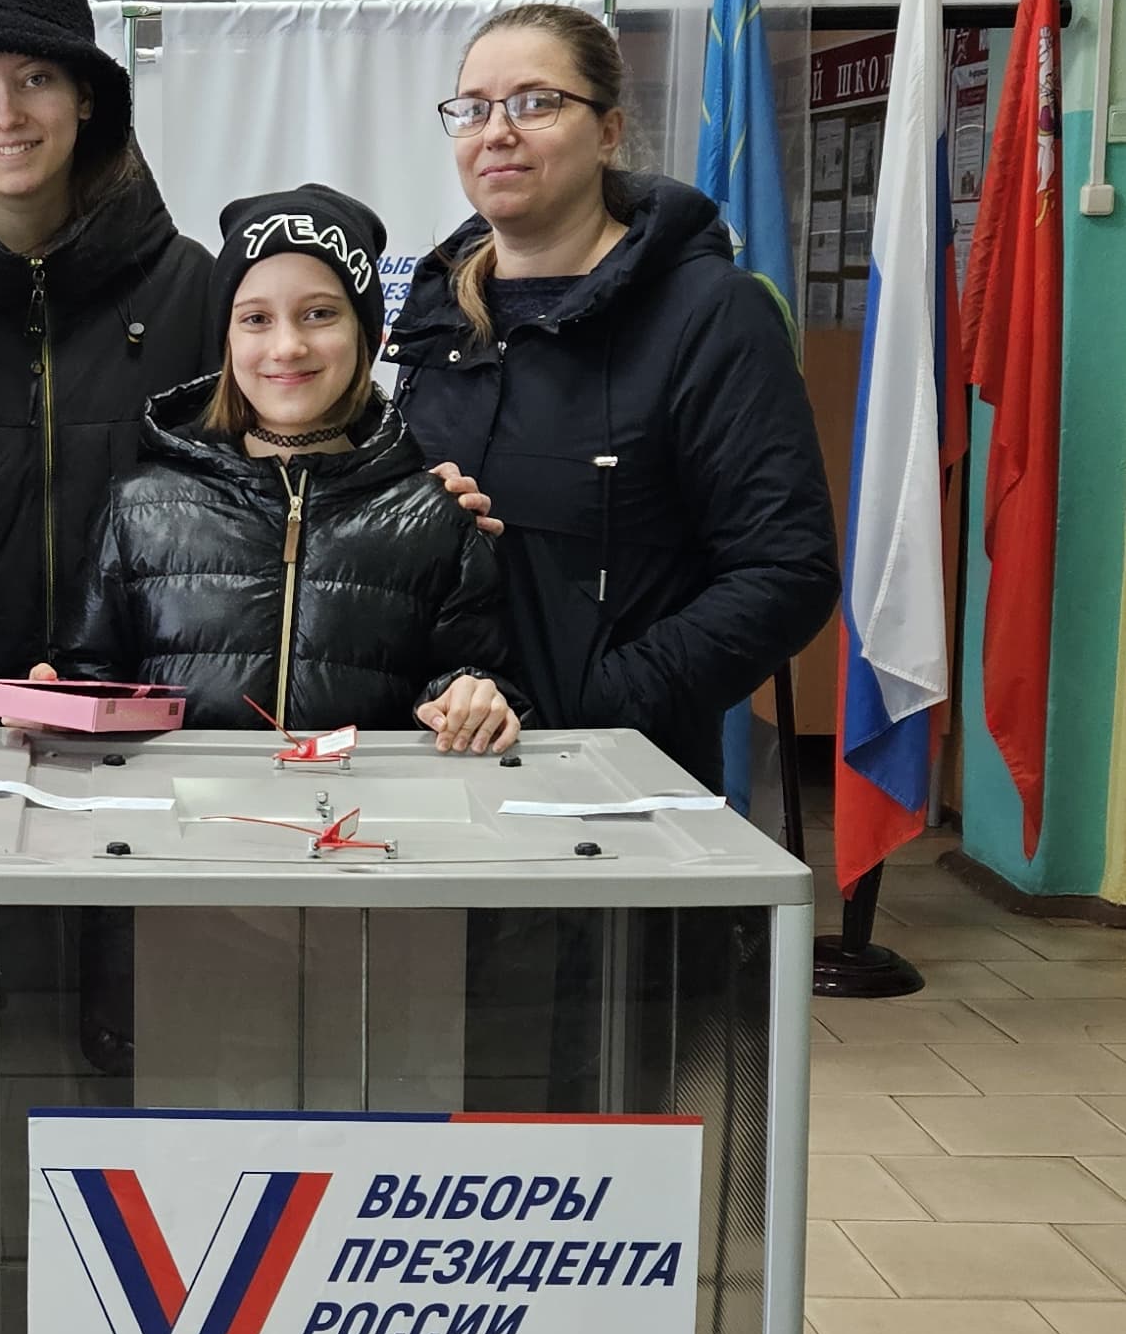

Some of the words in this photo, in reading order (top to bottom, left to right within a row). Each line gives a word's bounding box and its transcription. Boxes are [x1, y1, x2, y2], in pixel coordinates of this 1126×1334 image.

[836, 53, 893, 98] ШКОЛ
[243, 214, 372, 294] YEAH
[358, 1174, 610, 1222] ВЫБОРЫ
[329, 1238, 682, 1291] ПРЕЗИДЕНТА
